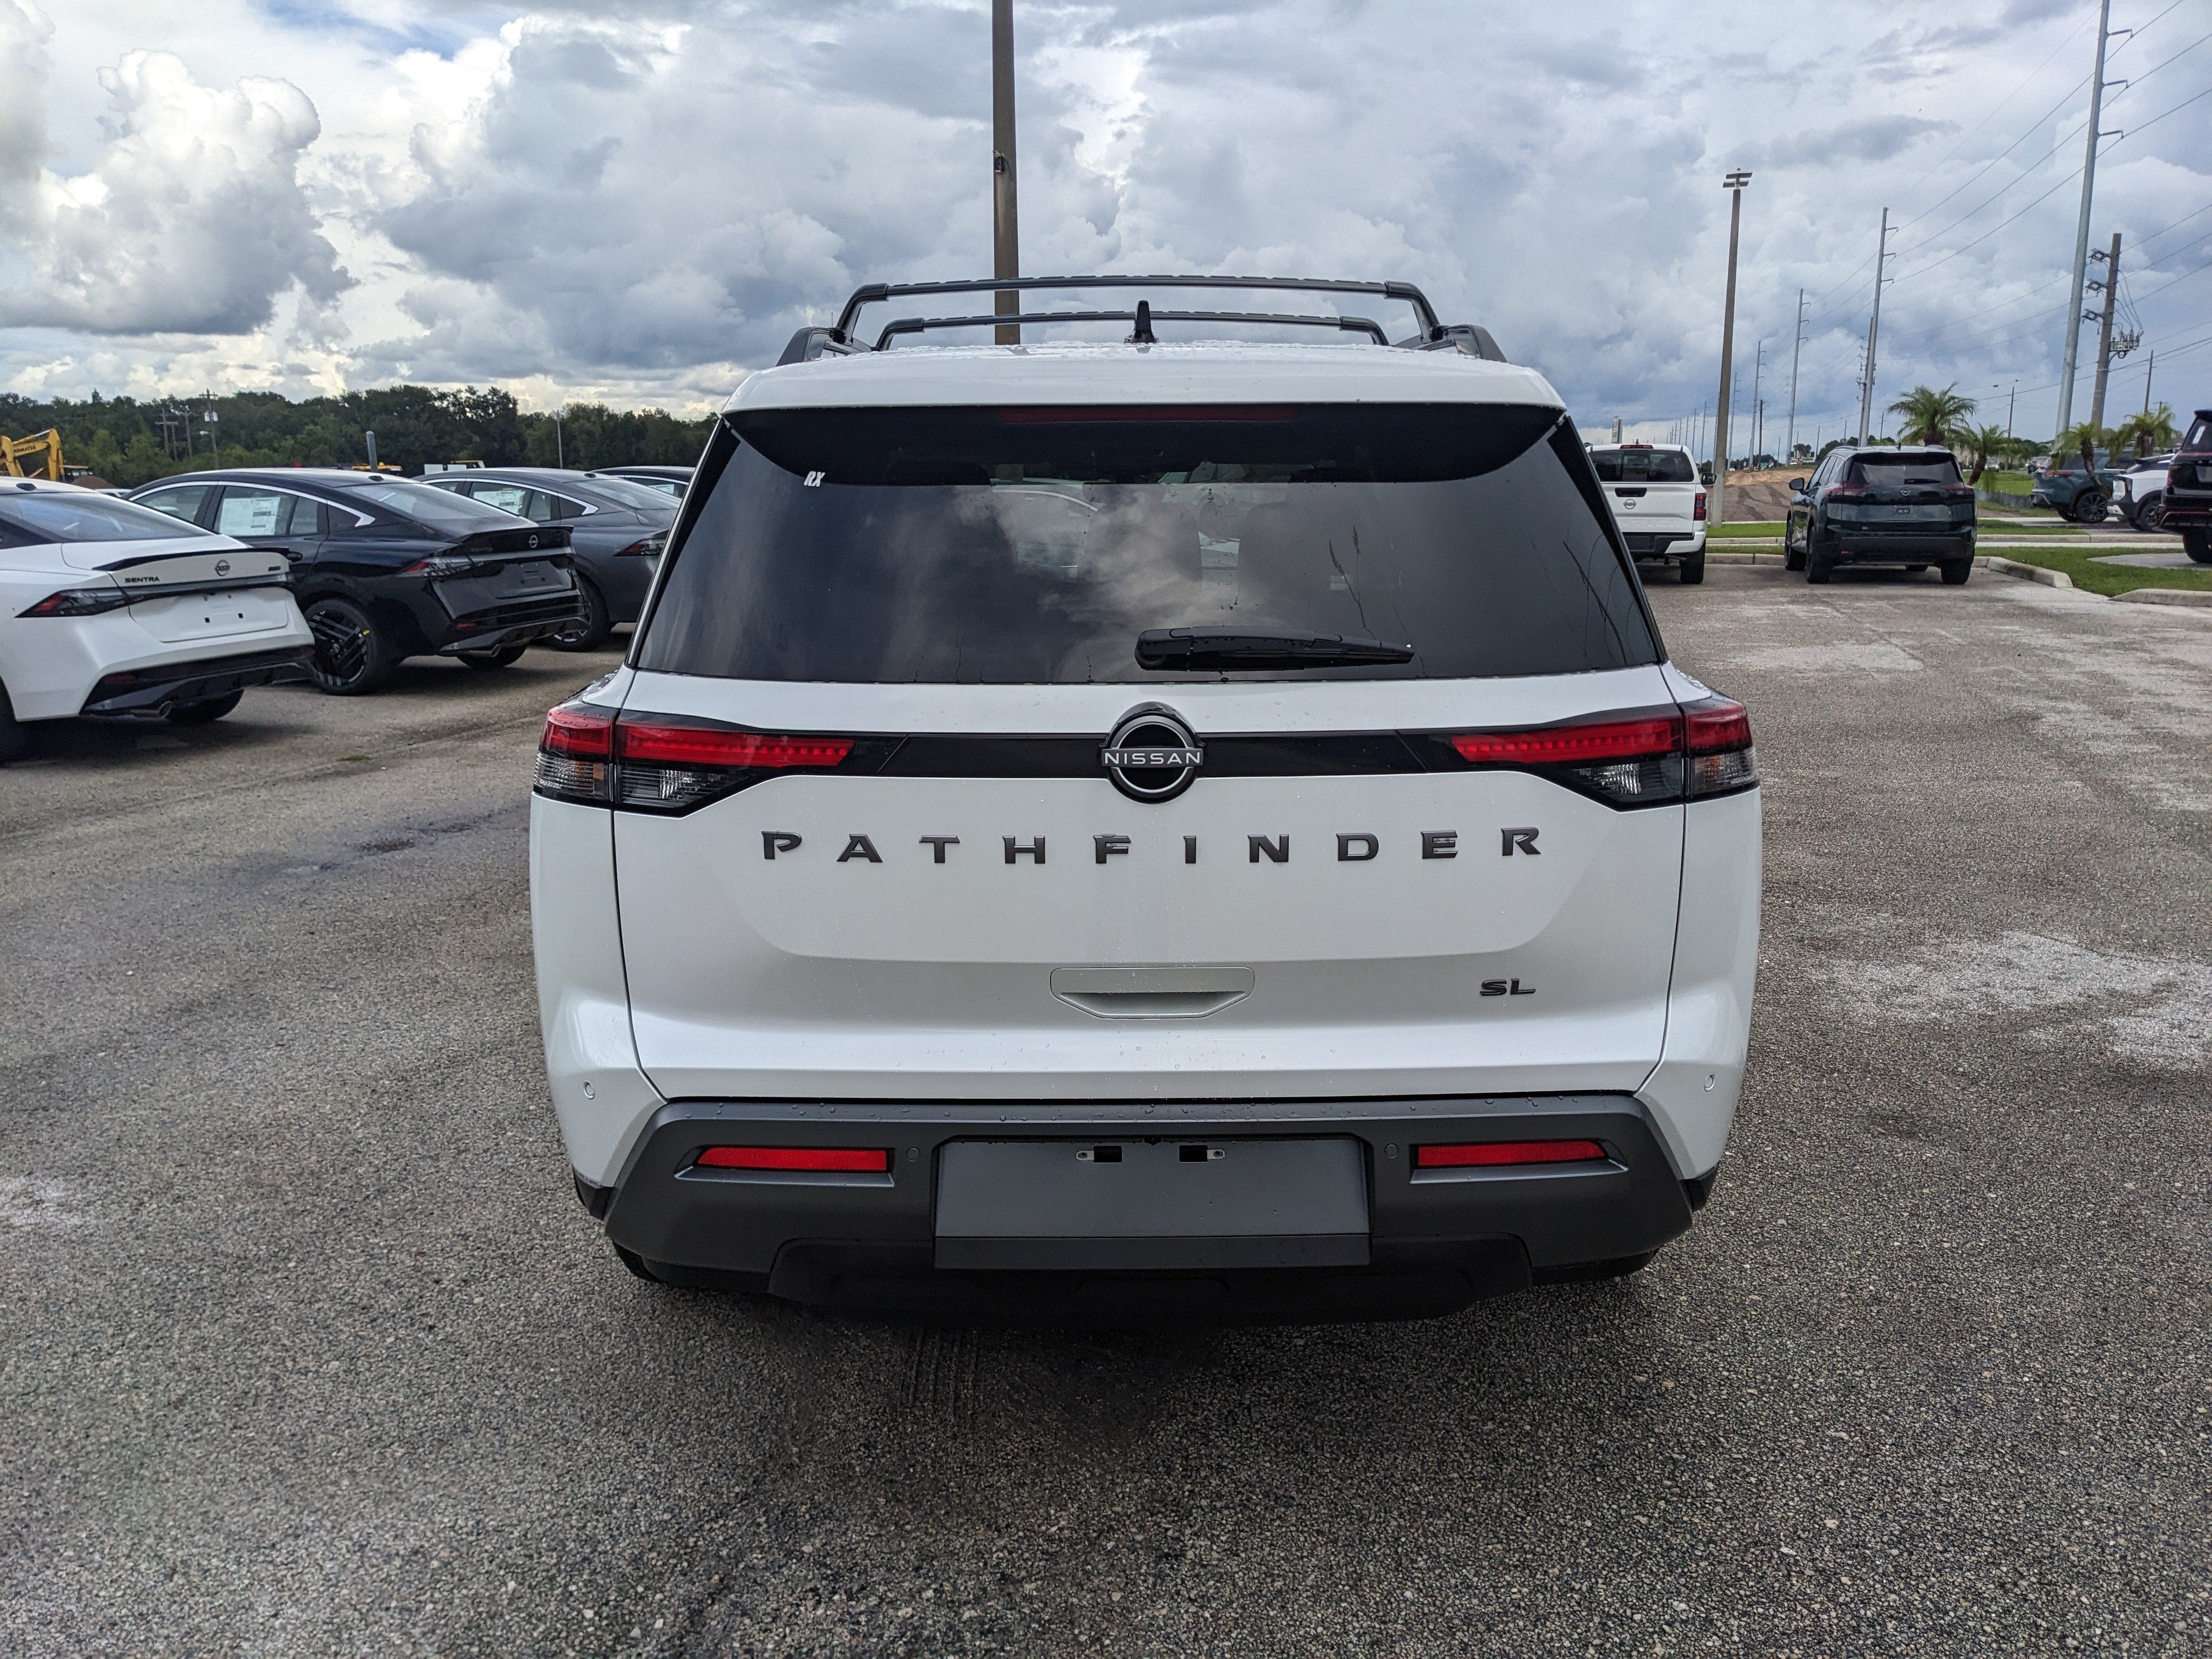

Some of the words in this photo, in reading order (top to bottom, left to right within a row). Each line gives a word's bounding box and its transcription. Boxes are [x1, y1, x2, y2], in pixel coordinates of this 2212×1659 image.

[804, 471, 826, 487] RX
[1104, 752, 1200, 765] NISSAN
[761, 827, 1542, 864] PATHFINDER
[1480, 978, 1537, 996] SL
